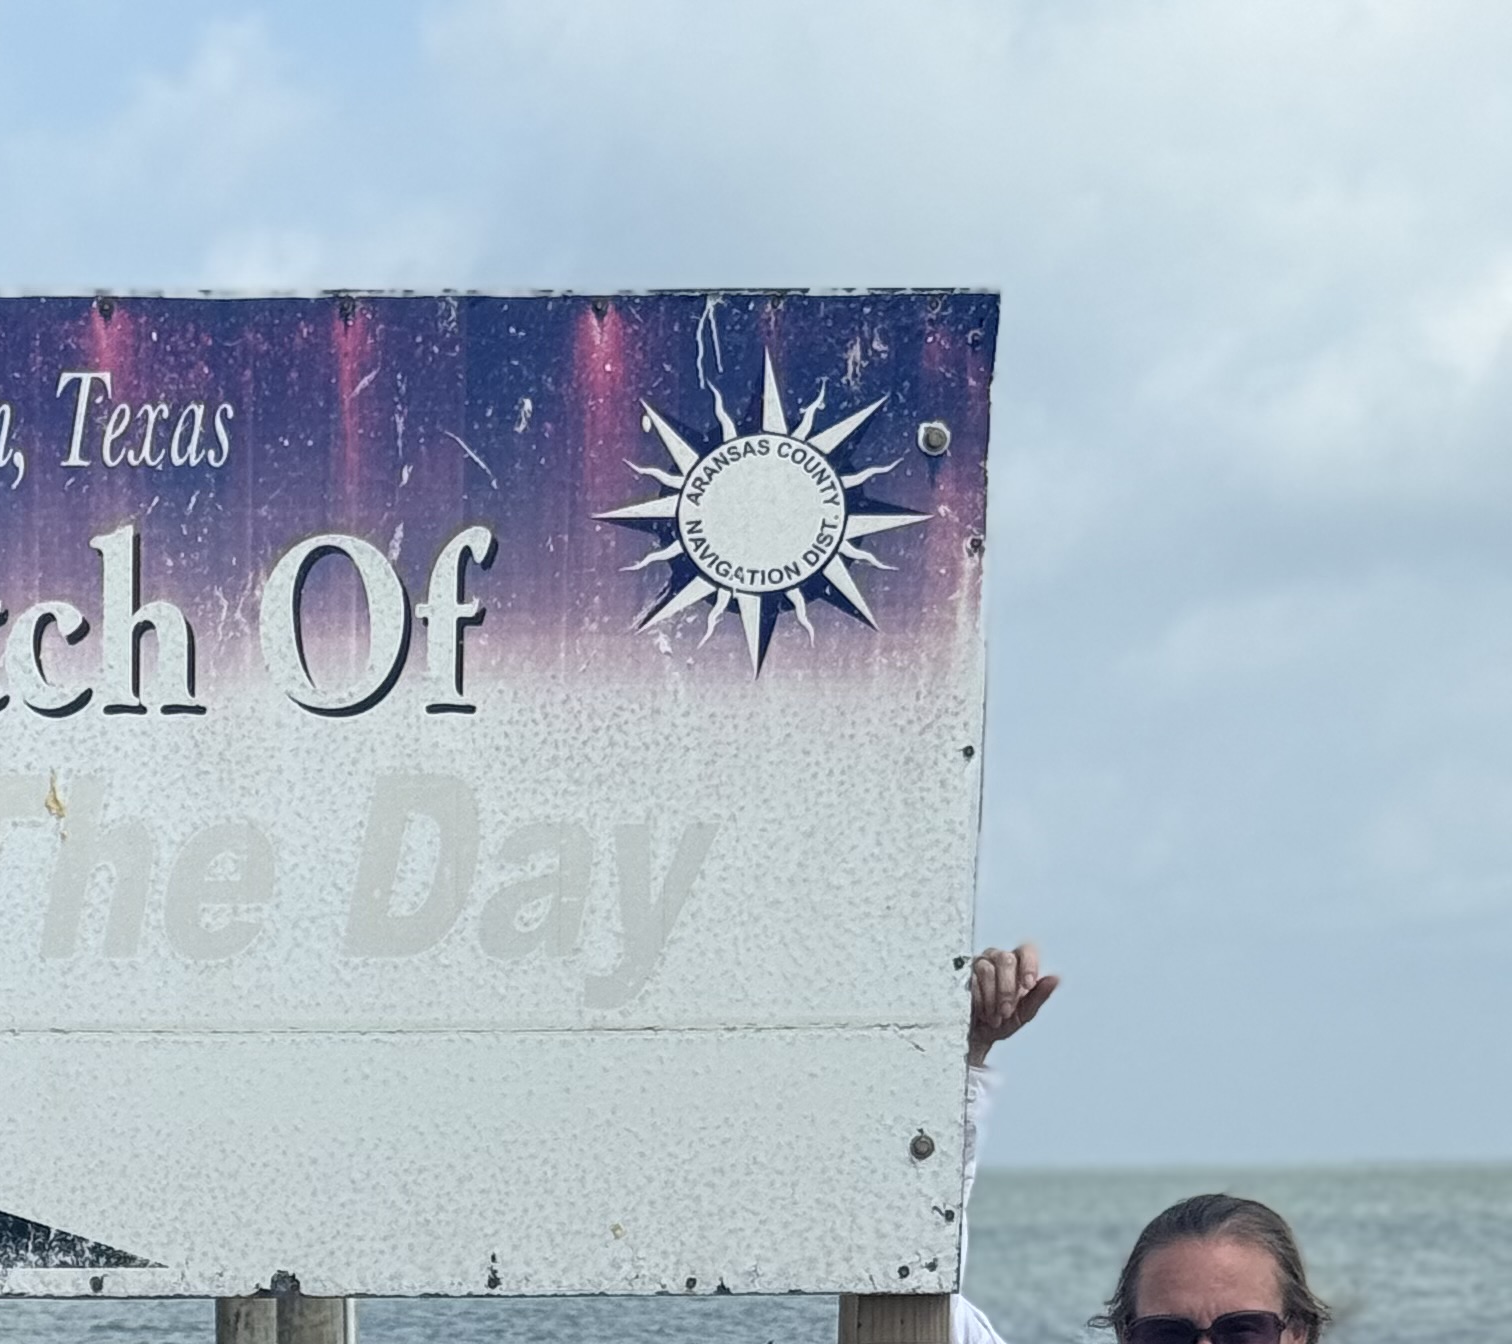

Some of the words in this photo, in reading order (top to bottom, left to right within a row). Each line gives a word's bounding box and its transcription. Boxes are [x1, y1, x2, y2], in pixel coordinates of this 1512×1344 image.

[55, 370, 235, 469] Texas
[687, 439, 770, 506] ARANSAS
[776, 441, 840, 507] COUNTY
[685, 519, 802, 586] NAVIGATION
[802, 515, 840, 567] DIST.
[258, 526, 498, 717] Of
[338, 773, 721, 1010] Day
